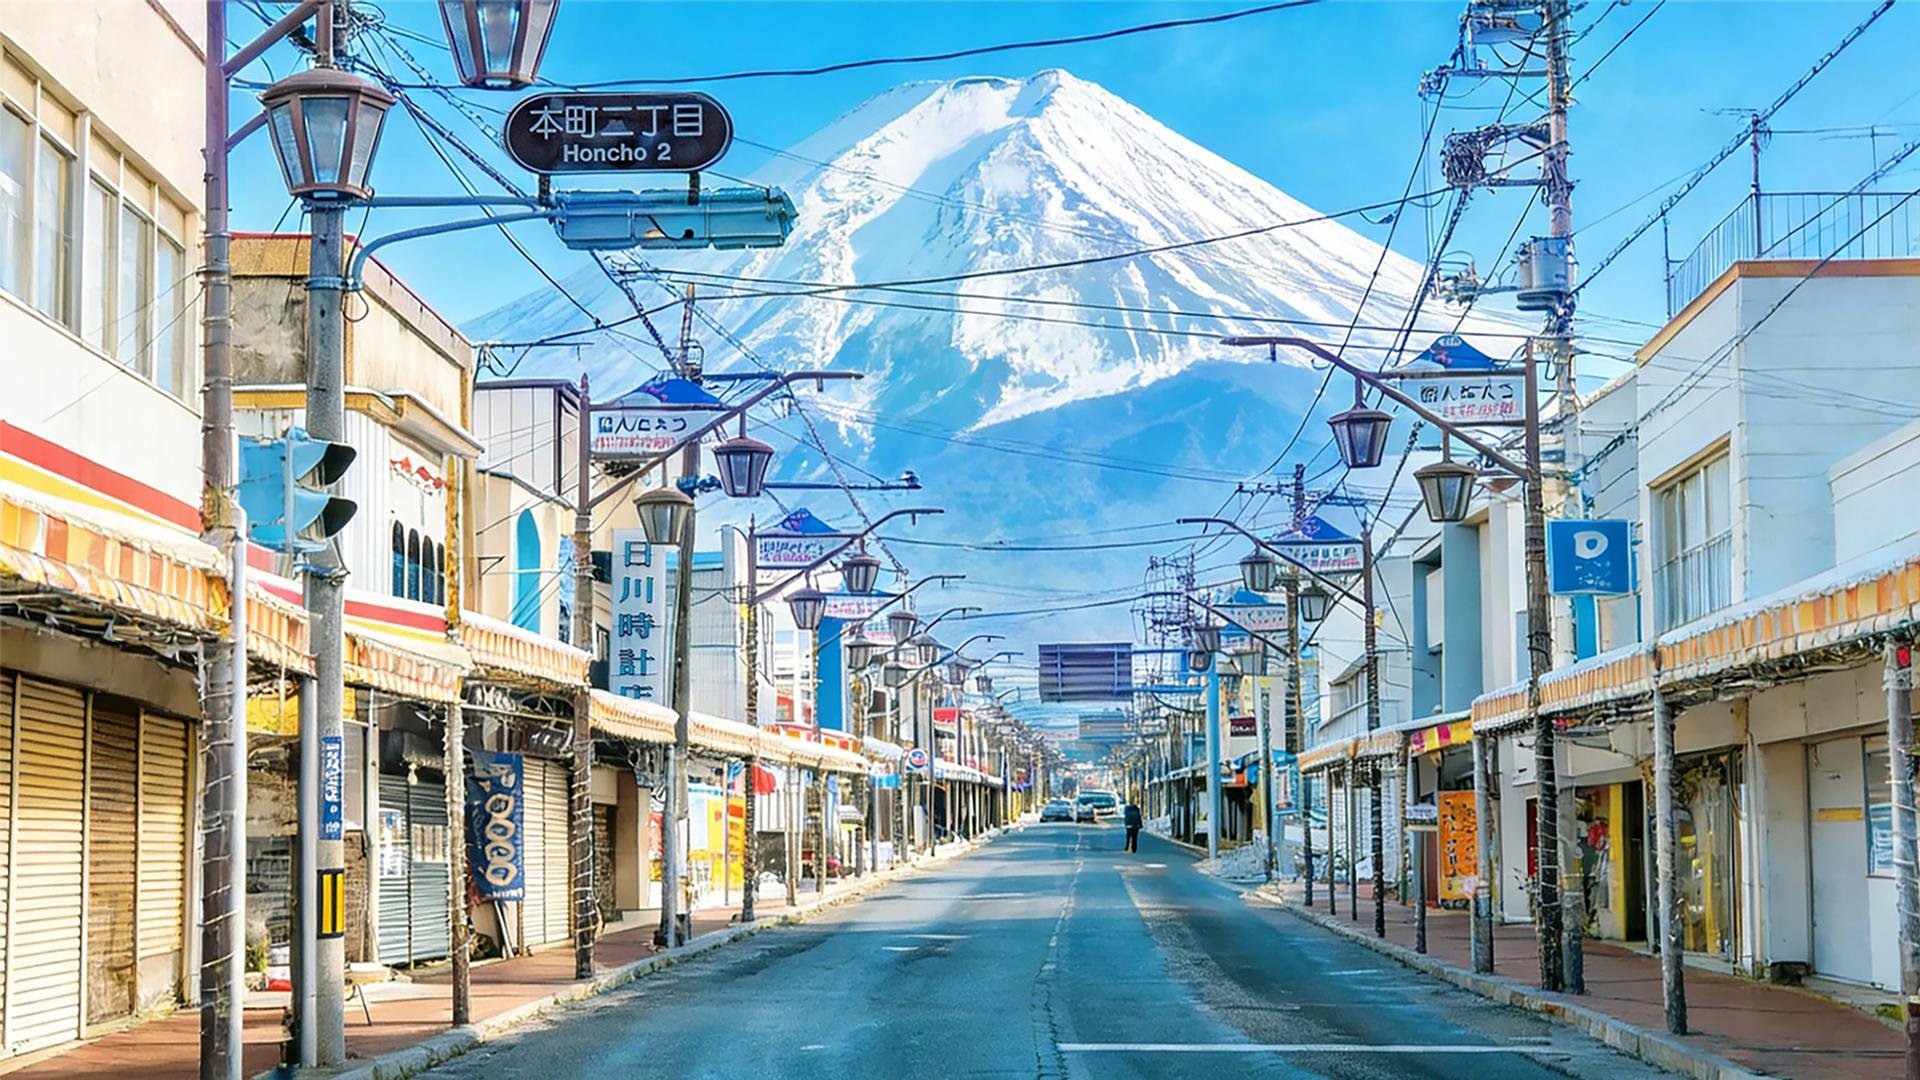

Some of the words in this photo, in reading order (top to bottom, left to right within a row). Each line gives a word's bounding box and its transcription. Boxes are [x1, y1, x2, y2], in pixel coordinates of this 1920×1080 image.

[529, 104, 703, 140] 本町二丁目
[563, 143, 647, 162] Honcho
[657, 143, 671, 161] 2
